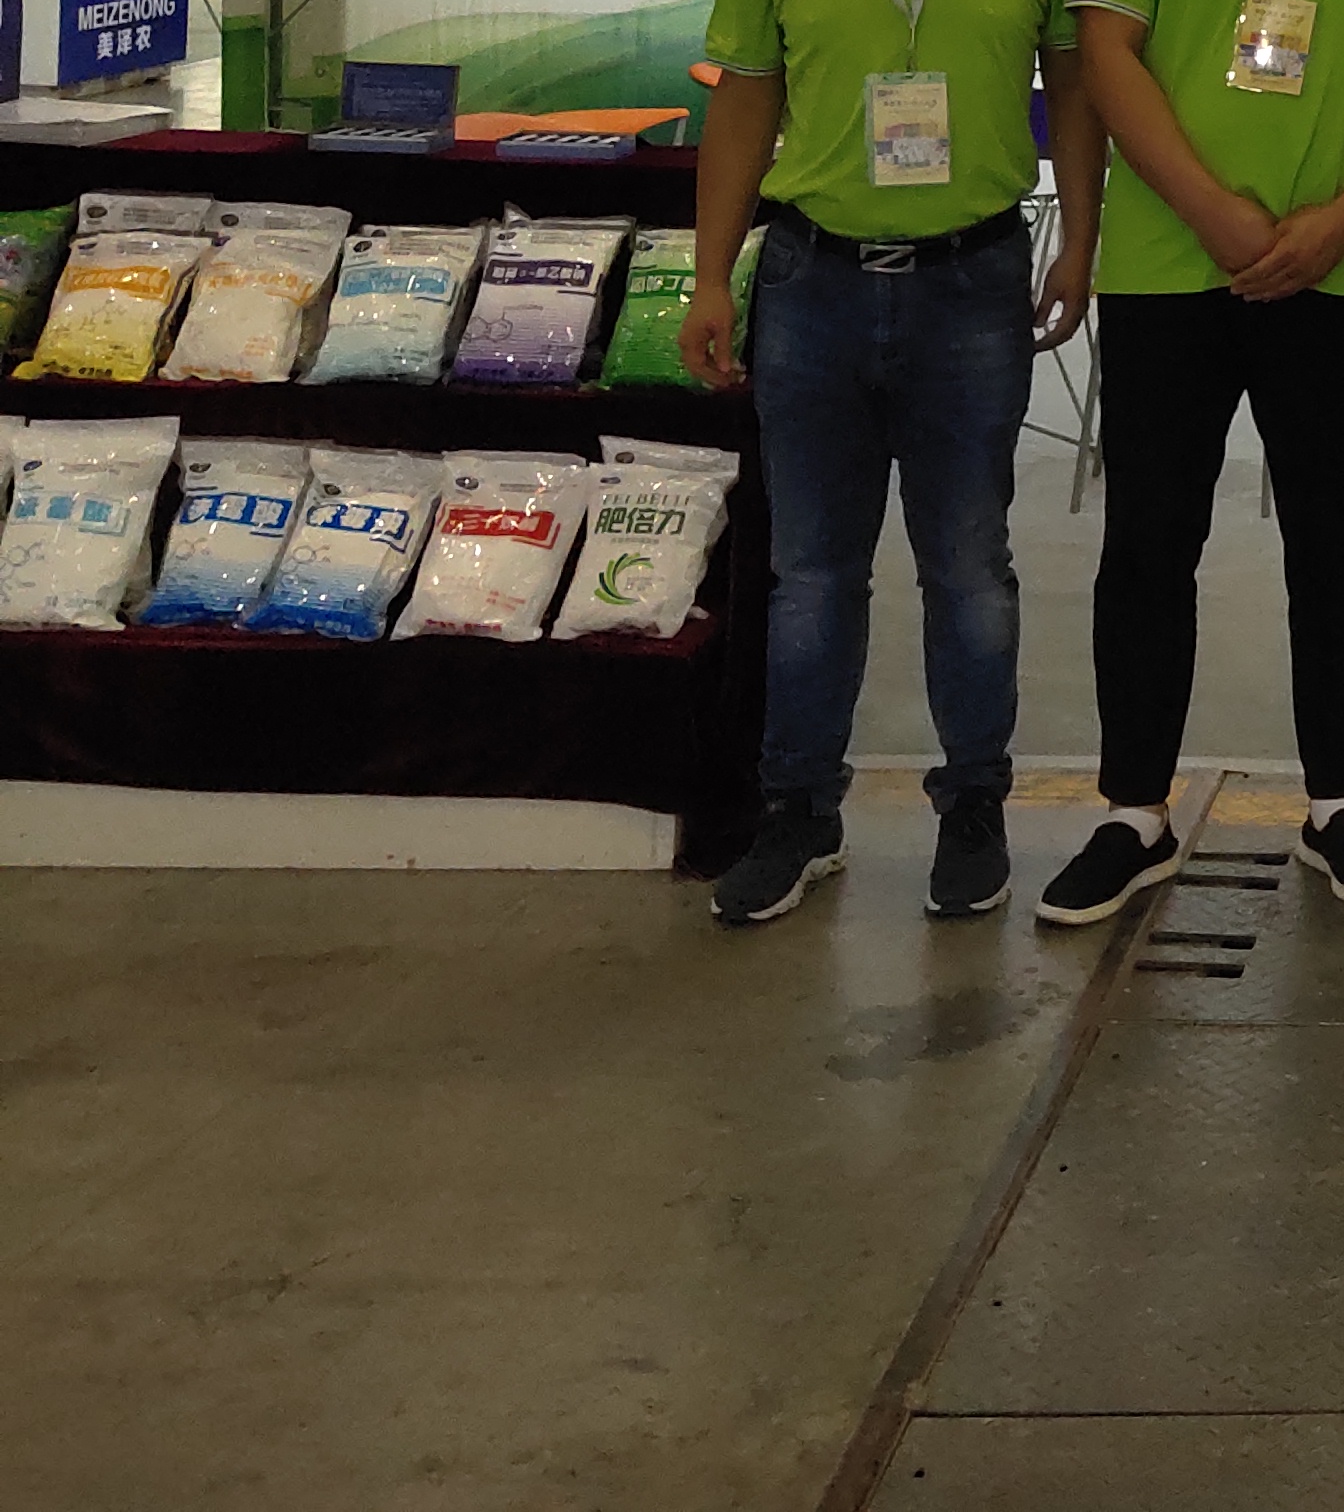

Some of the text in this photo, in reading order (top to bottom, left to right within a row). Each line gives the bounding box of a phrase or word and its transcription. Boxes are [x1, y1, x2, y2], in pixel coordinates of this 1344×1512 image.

[96, 26, 151, 59] 美泽农
[594, 507, 686, 535] 肥倍力
